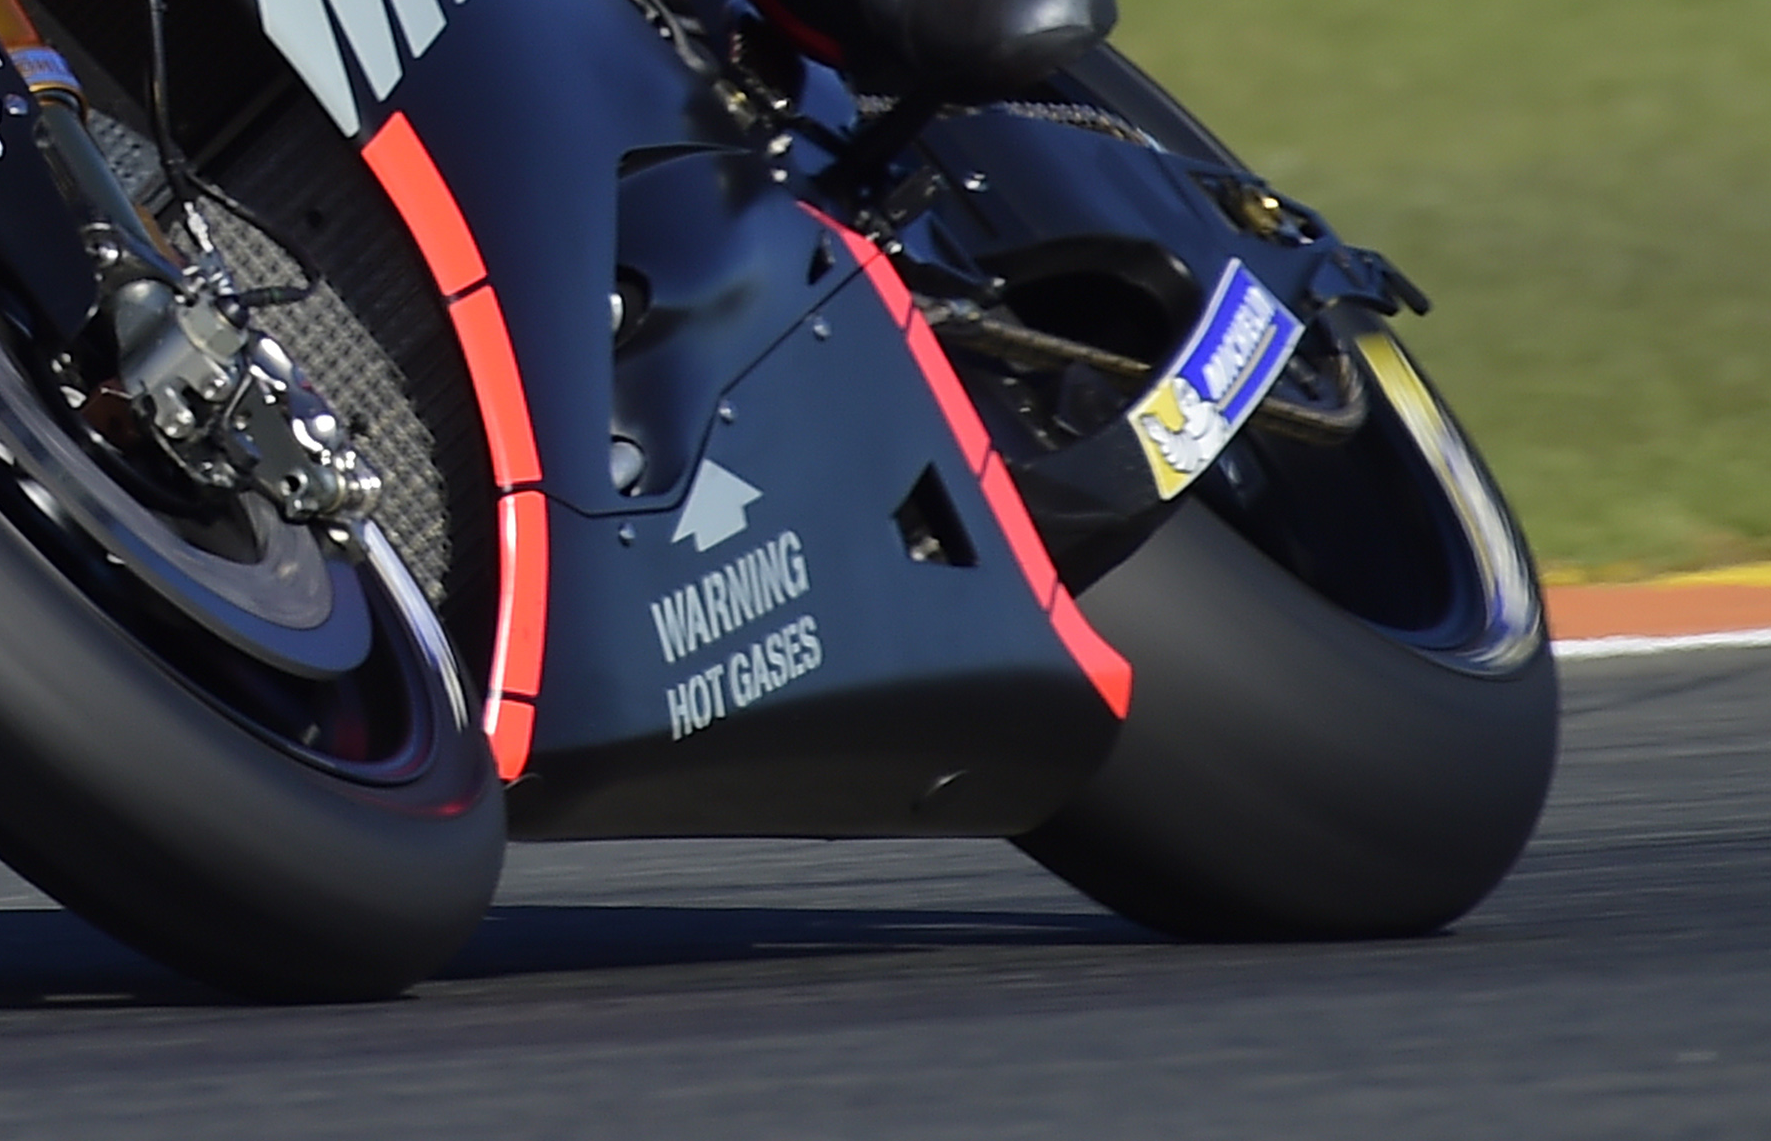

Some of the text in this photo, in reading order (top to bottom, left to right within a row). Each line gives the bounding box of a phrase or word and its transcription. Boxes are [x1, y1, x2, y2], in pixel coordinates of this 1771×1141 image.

[650, 530, 810, 663] WARNING
[666, 615, 823, 741] HOT GASES
